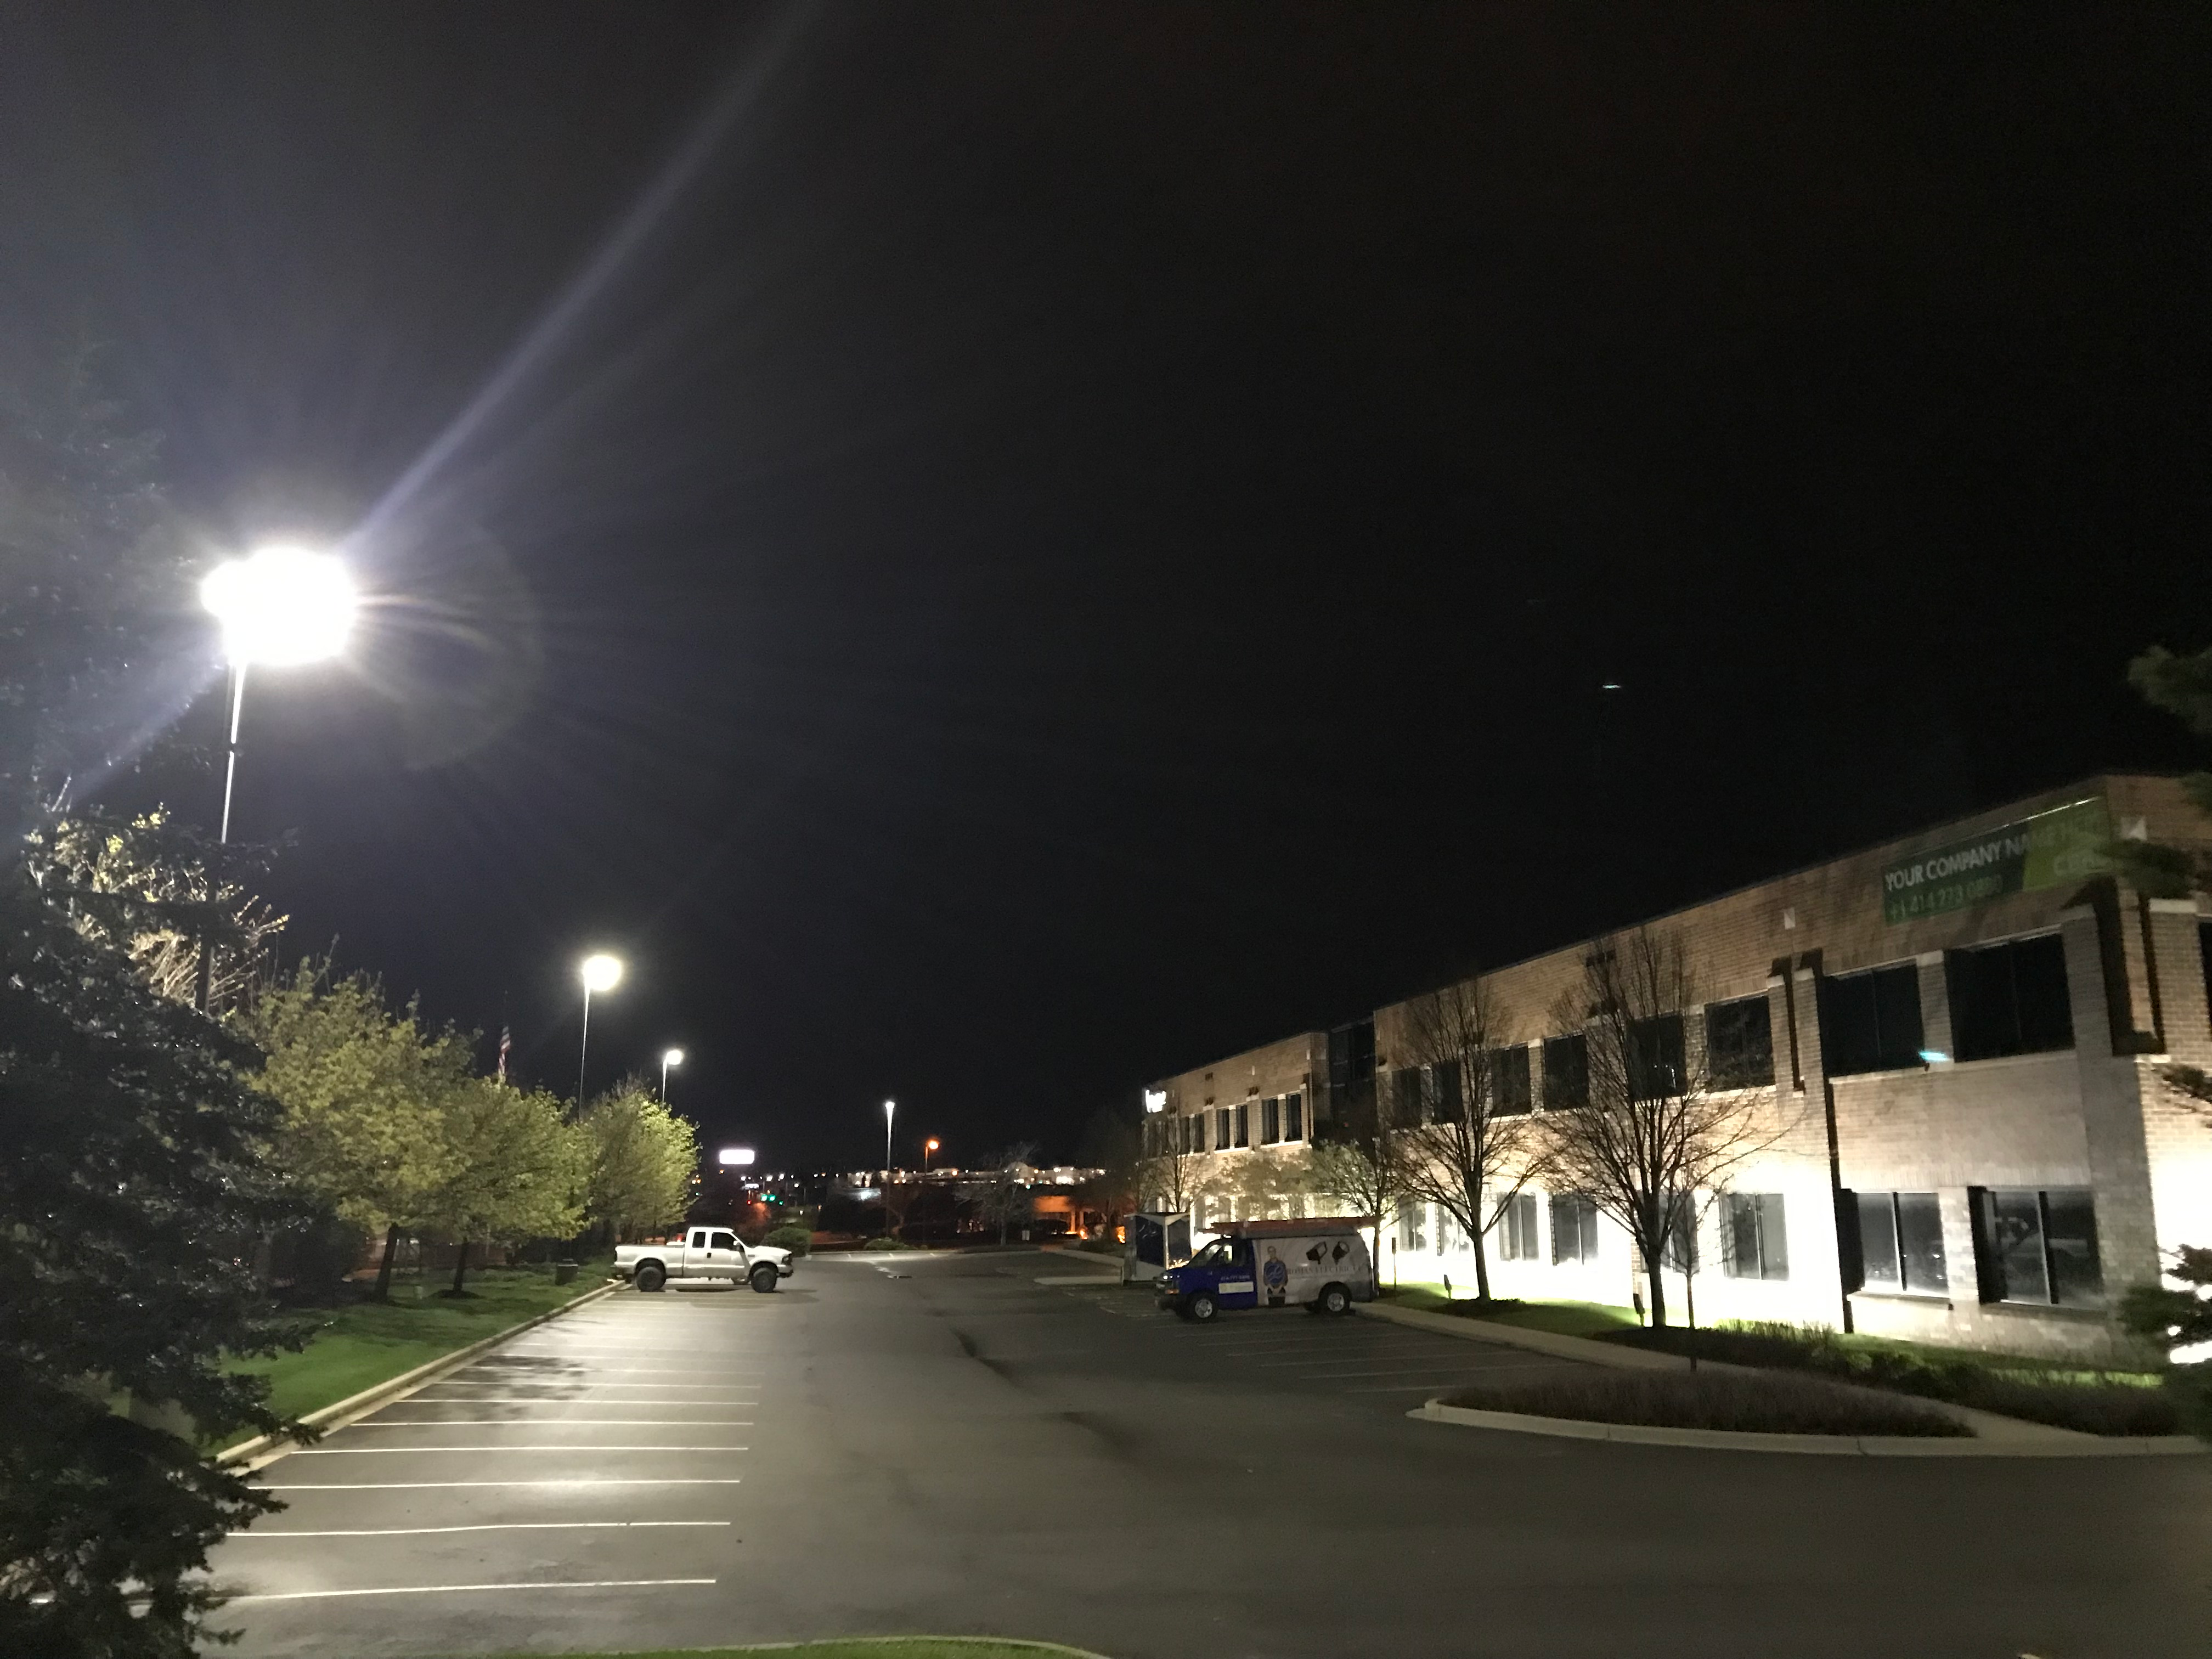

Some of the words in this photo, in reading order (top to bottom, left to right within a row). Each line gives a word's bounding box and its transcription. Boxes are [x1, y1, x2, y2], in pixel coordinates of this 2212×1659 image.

[1884, 865, 1925, 892] YOUR
[1926, 841, 2002, 880] COMPANY
[1910, 891, 1936, 913] 414
[1938, 884, 1963, 907] 273
